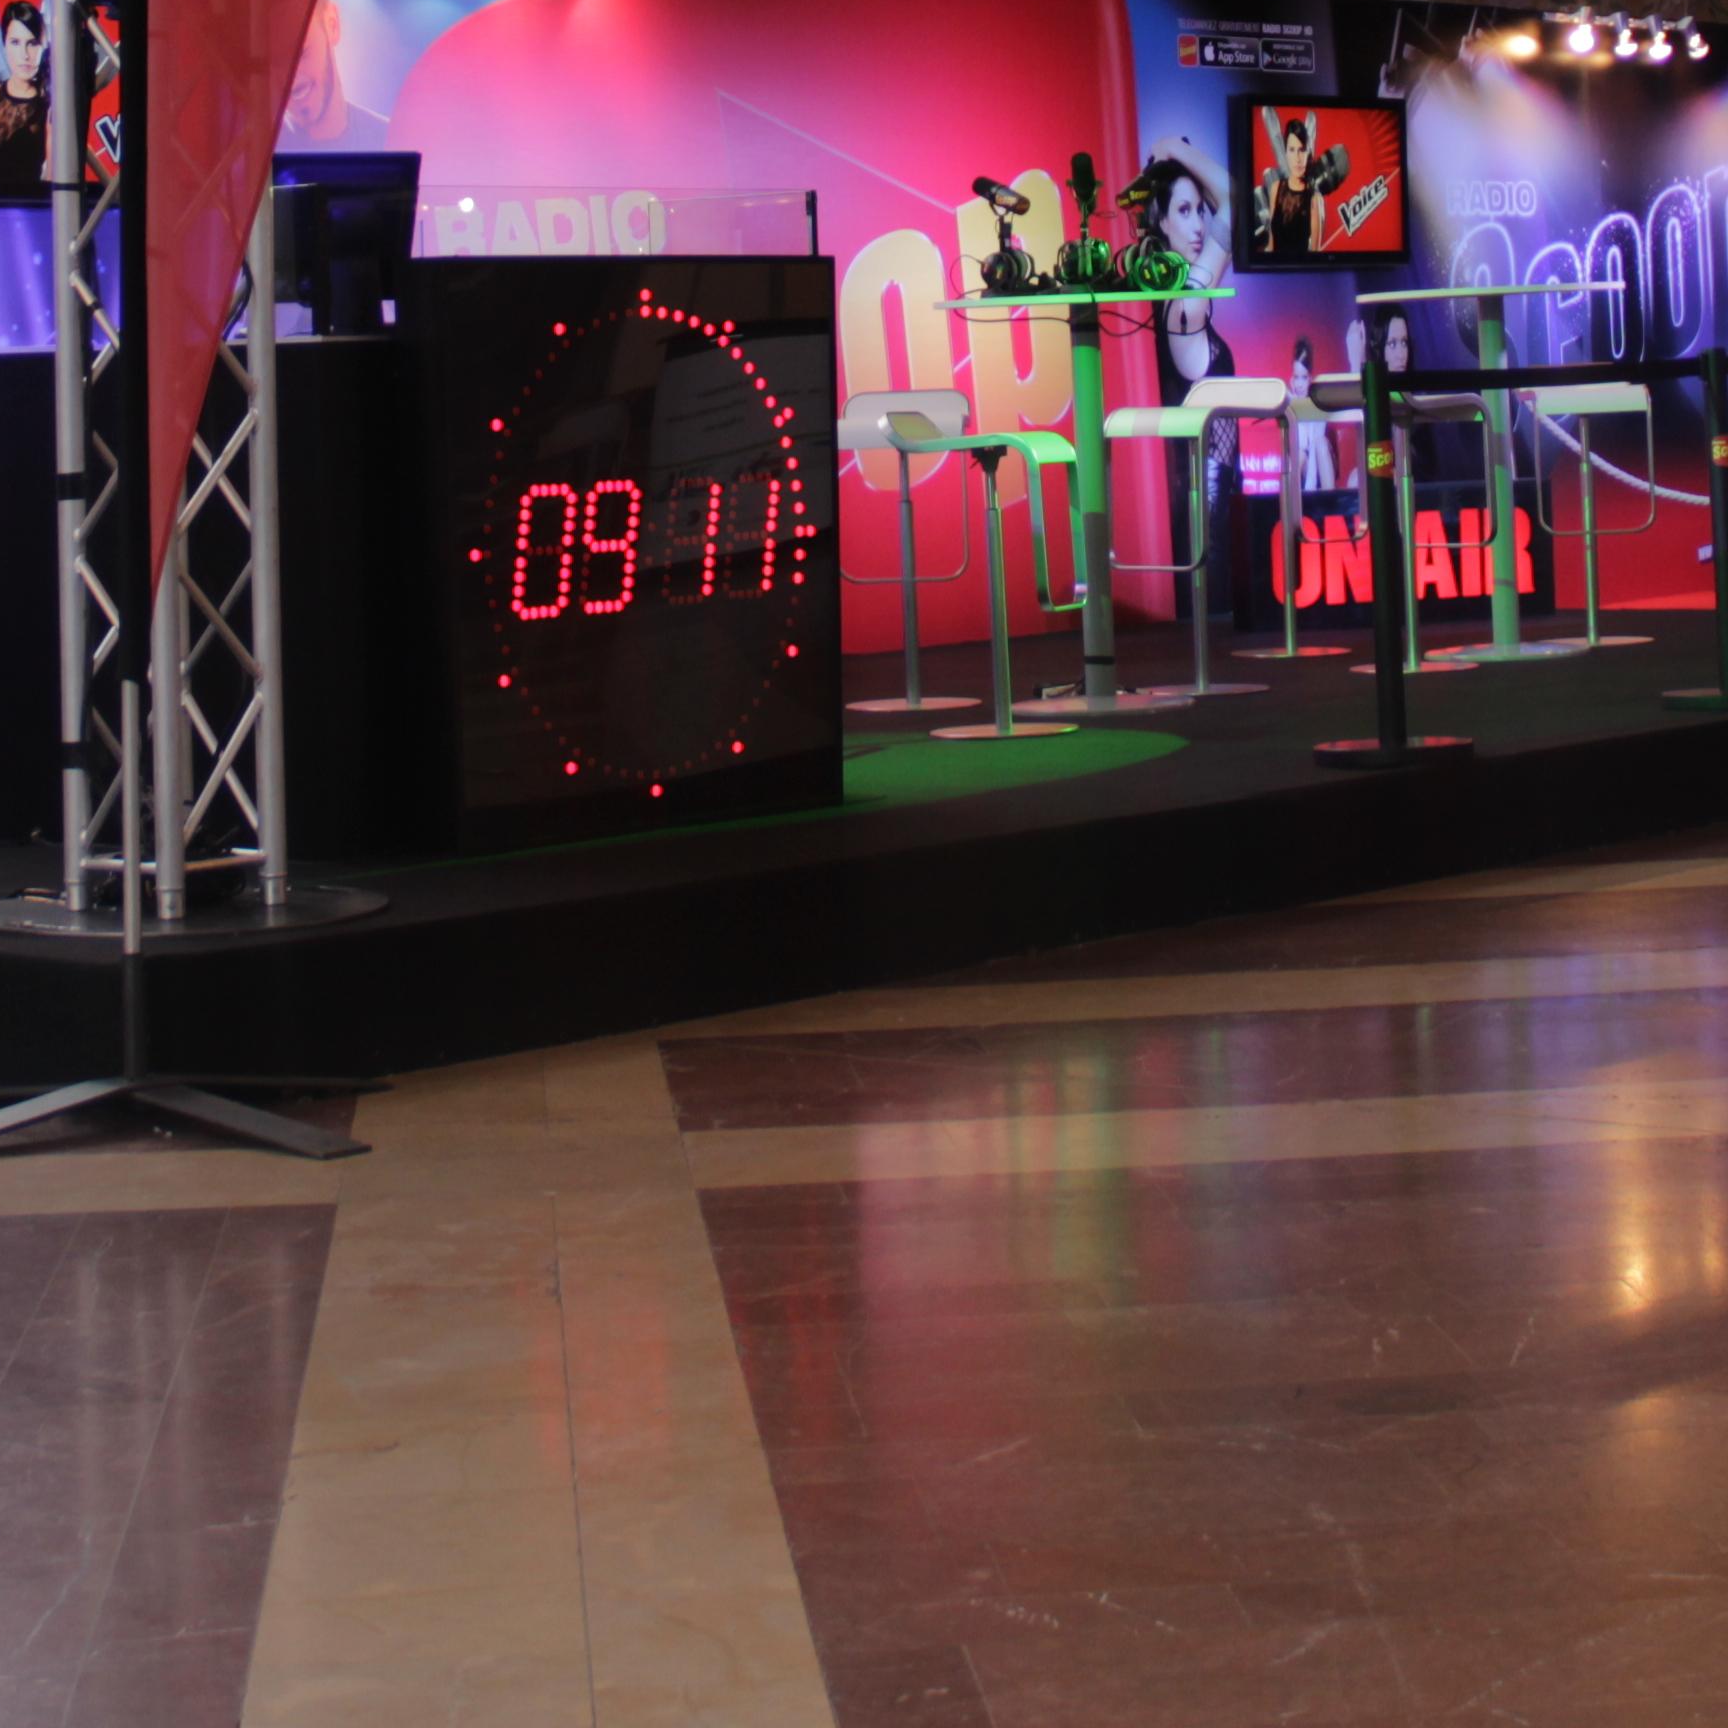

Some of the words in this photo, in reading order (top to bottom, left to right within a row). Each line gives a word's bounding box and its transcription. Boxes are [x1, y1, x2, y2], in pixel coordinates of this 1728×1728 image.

[433, 190, 667, 256] RADIO
[1338, 175, 1388, 237] Voice
[1446, 180, 1537, 218] RADIO
[1271, 515, 1375, 609] ON
[1414, 506, 1535, 600] AIR
